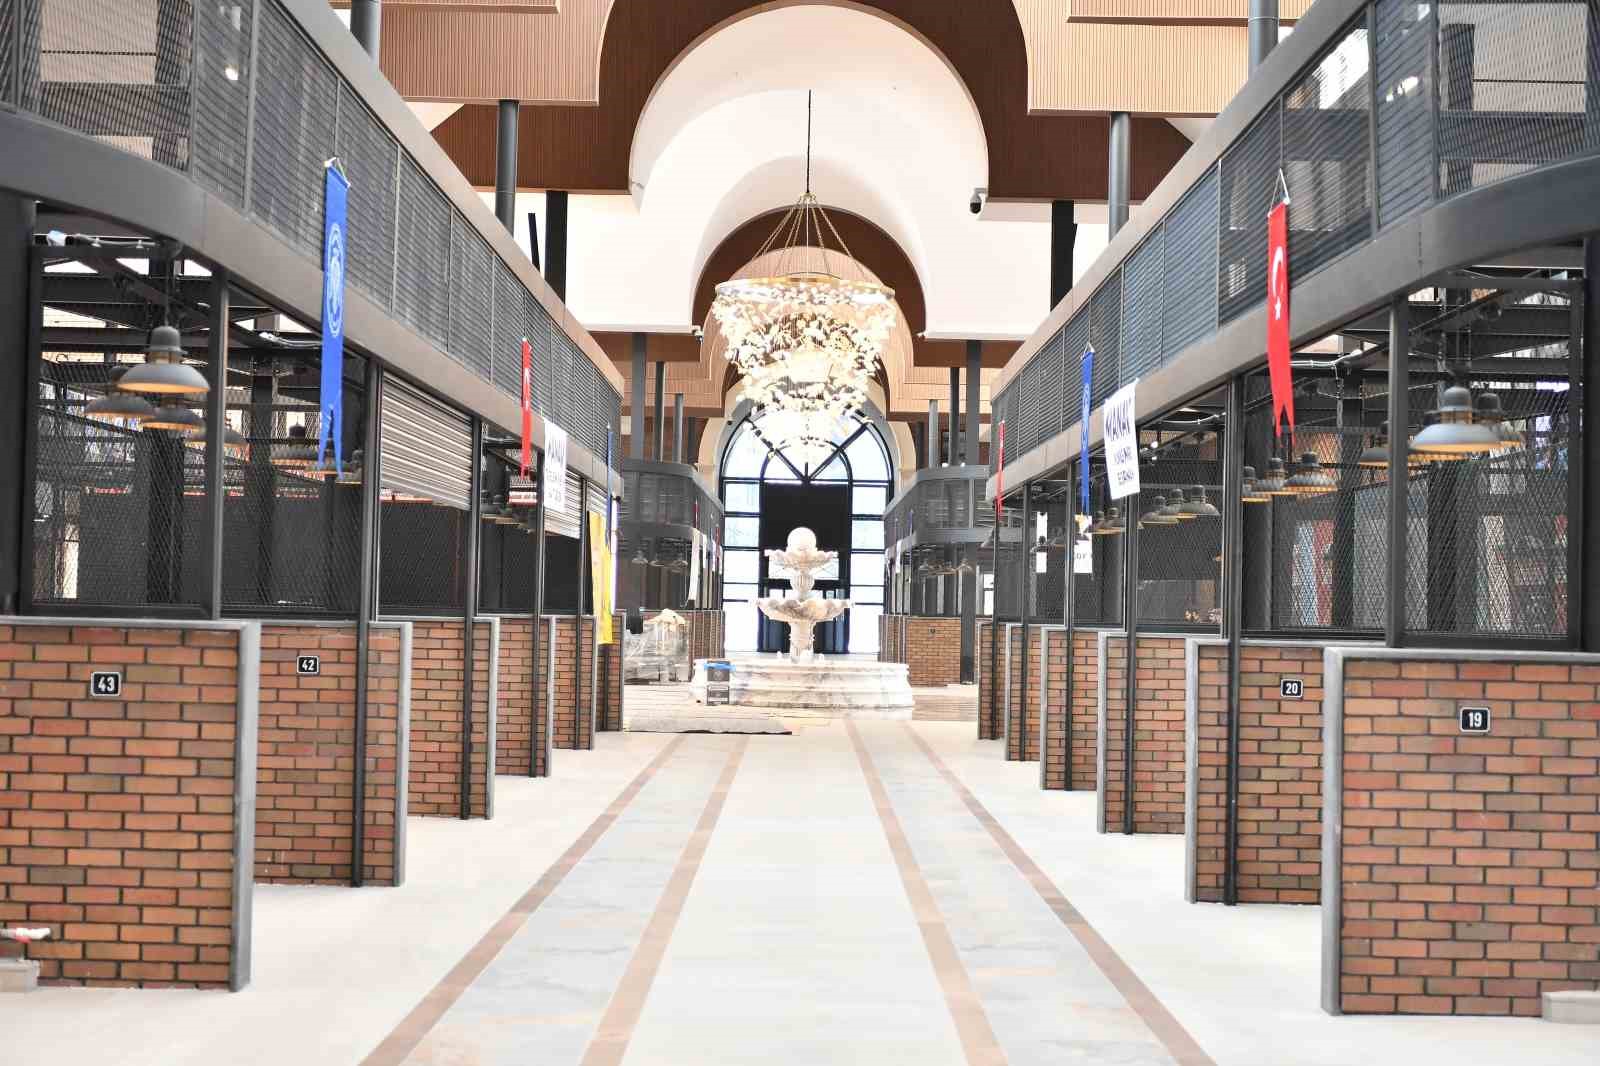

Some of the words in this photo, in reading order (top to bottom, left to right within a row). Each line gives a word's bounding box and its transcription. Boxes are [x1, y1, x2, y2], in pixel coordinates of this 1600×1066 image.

[301, 659, 315, 671] 42
[98, 676, 115, 692] 43
[1285, 682, 1298, 694] 20
[1468, 711, 1482, 728] 19
